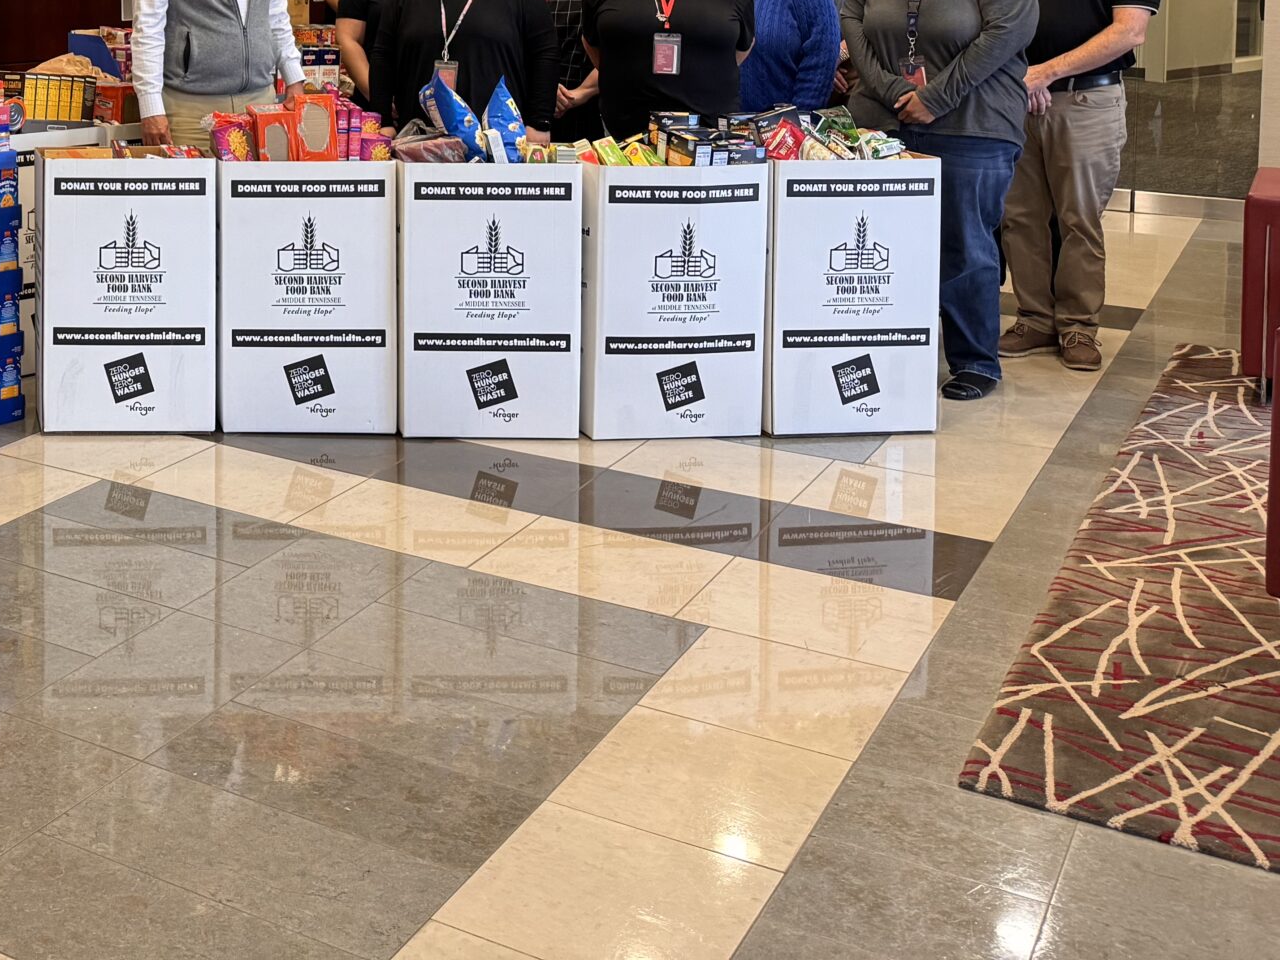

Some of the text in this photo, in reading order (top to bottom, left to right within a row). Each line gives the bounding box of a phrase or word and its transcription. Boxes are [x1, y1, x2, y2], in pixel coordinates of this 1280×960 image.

[60, 182, 200, 190] DONATE YOUR FOOD ITEMS HERE
[237, 184, 379, 193] DONATE YOUR FOOD ITEMS HERE
[420, 186, 565, 195] DONATE YOUR FOOD ITEMS HERE
[793, 182, 929, 192] DONATE YOUR FOOD ITEMS HERE
[615, 188, 754, 199] DONATE YOUR FOOD ITEMS HERE
[96, 274, 163, 283] SECOND HARVEST
[274, 276, 343, 285] SECOND HARVEST
[457, 279, 527, 289] SECOND HARVEST
[826, 275, 891, 285] SECOND HARVEST
[107, 283, 152, 293] FOOD BANK
[285, 285, 331, 295] FOOD BANK
[651, 282, 717, 293] SECOND HARVEST
[836, 285, 880, 295] FOOD BANK
[469, 289, 516, 299] FOOD BANK
[662, 292, 707, 302] FOOD BANK
[56, 332, 202, 342] www.secondharvestmidtn.org
[235, 334, 382, 344] www.secondharvestmidtn.org
[786, 332, 926, 343] www.secondharvestmidtn.org
[418, 338, 567, 349] www.secondharvestmidtn.org
[609, 338, 751, 350] www.secondharvestmidtn.org
[111, 366, 146, 383] HUNGER
[291, 368, 326, 385] HUNGER
[839, 367, 872, 384] HUNGER
[474, 372, 509, 389] HUNGER
[663, 374, 697, 390] HUNGER
[115, 382, 142, 397] WASTE
[295, 384, 323, 399] WASTE
[842, 384, 869, 399] WASTE
[478, 389, 506, 403] WASTE
[667, 391, 694, 404] WASTE
[130, 401, 156, 416] Kroger
[310, 403, 336, 418] Kroger
[856, 402, 881, 417] Kroger
[492, 407, 519, 423] Kroger
[680, 409, 705, 423] Kroger
